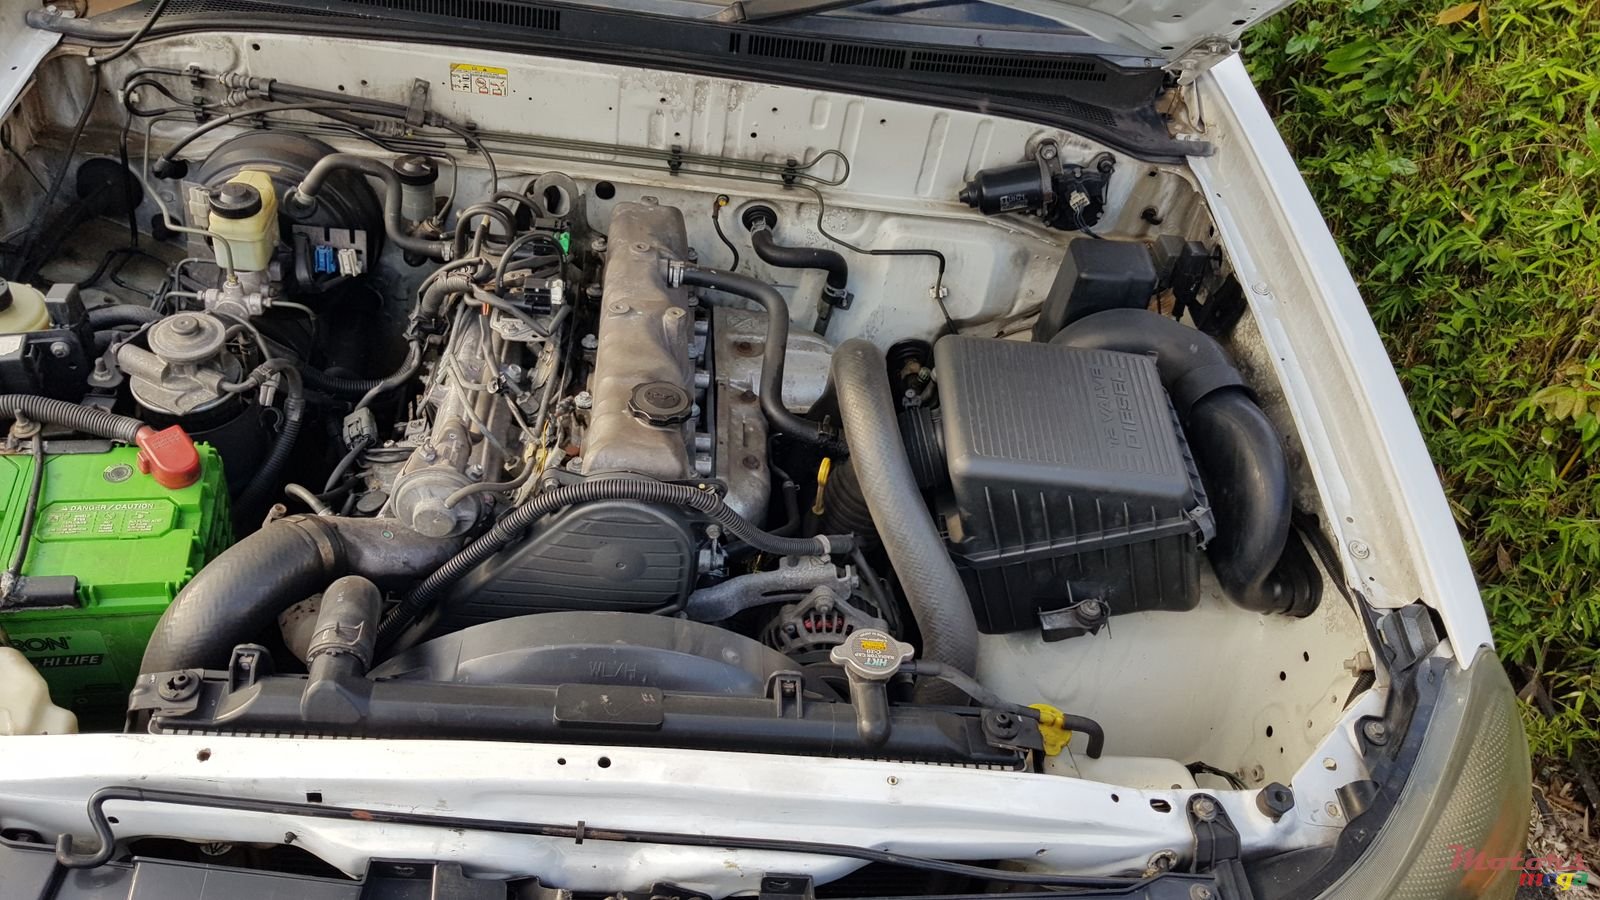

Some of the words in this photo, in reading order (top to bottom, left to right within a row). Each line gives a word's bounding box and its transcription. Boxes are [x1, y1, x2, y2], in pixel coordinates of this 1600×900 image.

[1089, 367, 1113, 423] VALVE
[1111, 371, 1142, 450] DIESEL
[43, 656, 60, 666] HI
[65, 655, 99, 666] LIFE
[864, 657, 887, 667] HKT
